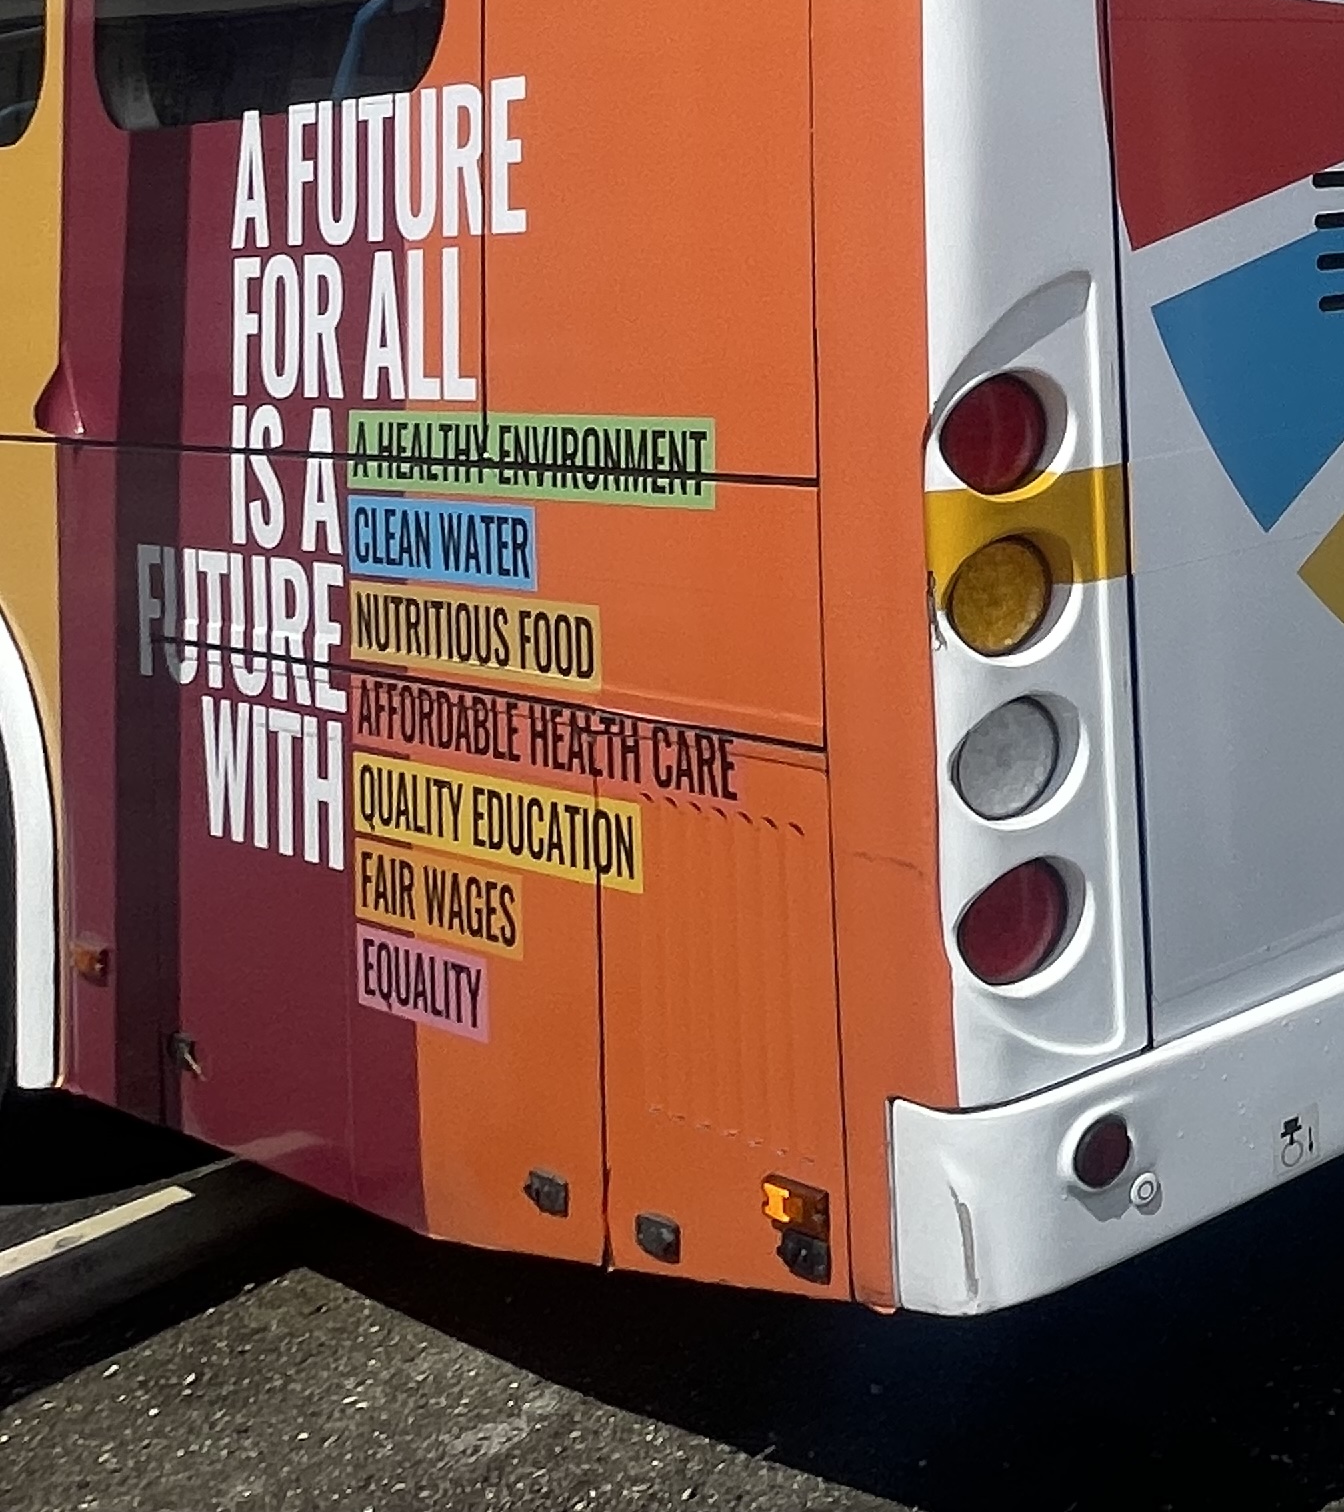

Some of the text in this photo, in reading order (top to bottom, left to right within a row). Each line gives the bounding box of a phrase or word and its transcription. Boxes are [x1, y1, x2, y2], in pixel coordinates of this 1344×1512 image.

[231, 75, 527, 249] A FUTURE
[232, 247, 477, 401] FOR ALL
[230, 404, 343, 554] IS A
[353, 422, 708, 496] A HEALTHY ENVIRONMENT
[354, 506, 531, 579] CLEAN WATER
[137, 543, 347, 713] FUTURE
[356, 592, 594, 680] NUTRITIOUS FOOD
[201, 695, 344, 871] WITH
[358, 679, 738, 802] AFFORDABLE HEALTH CARE
[359, 764, 635, 880] QUALITY EDUCATION
[360, 851, 517, 948] FAIR WAGES
[363, 938, 482, 1029] EQUALITY
